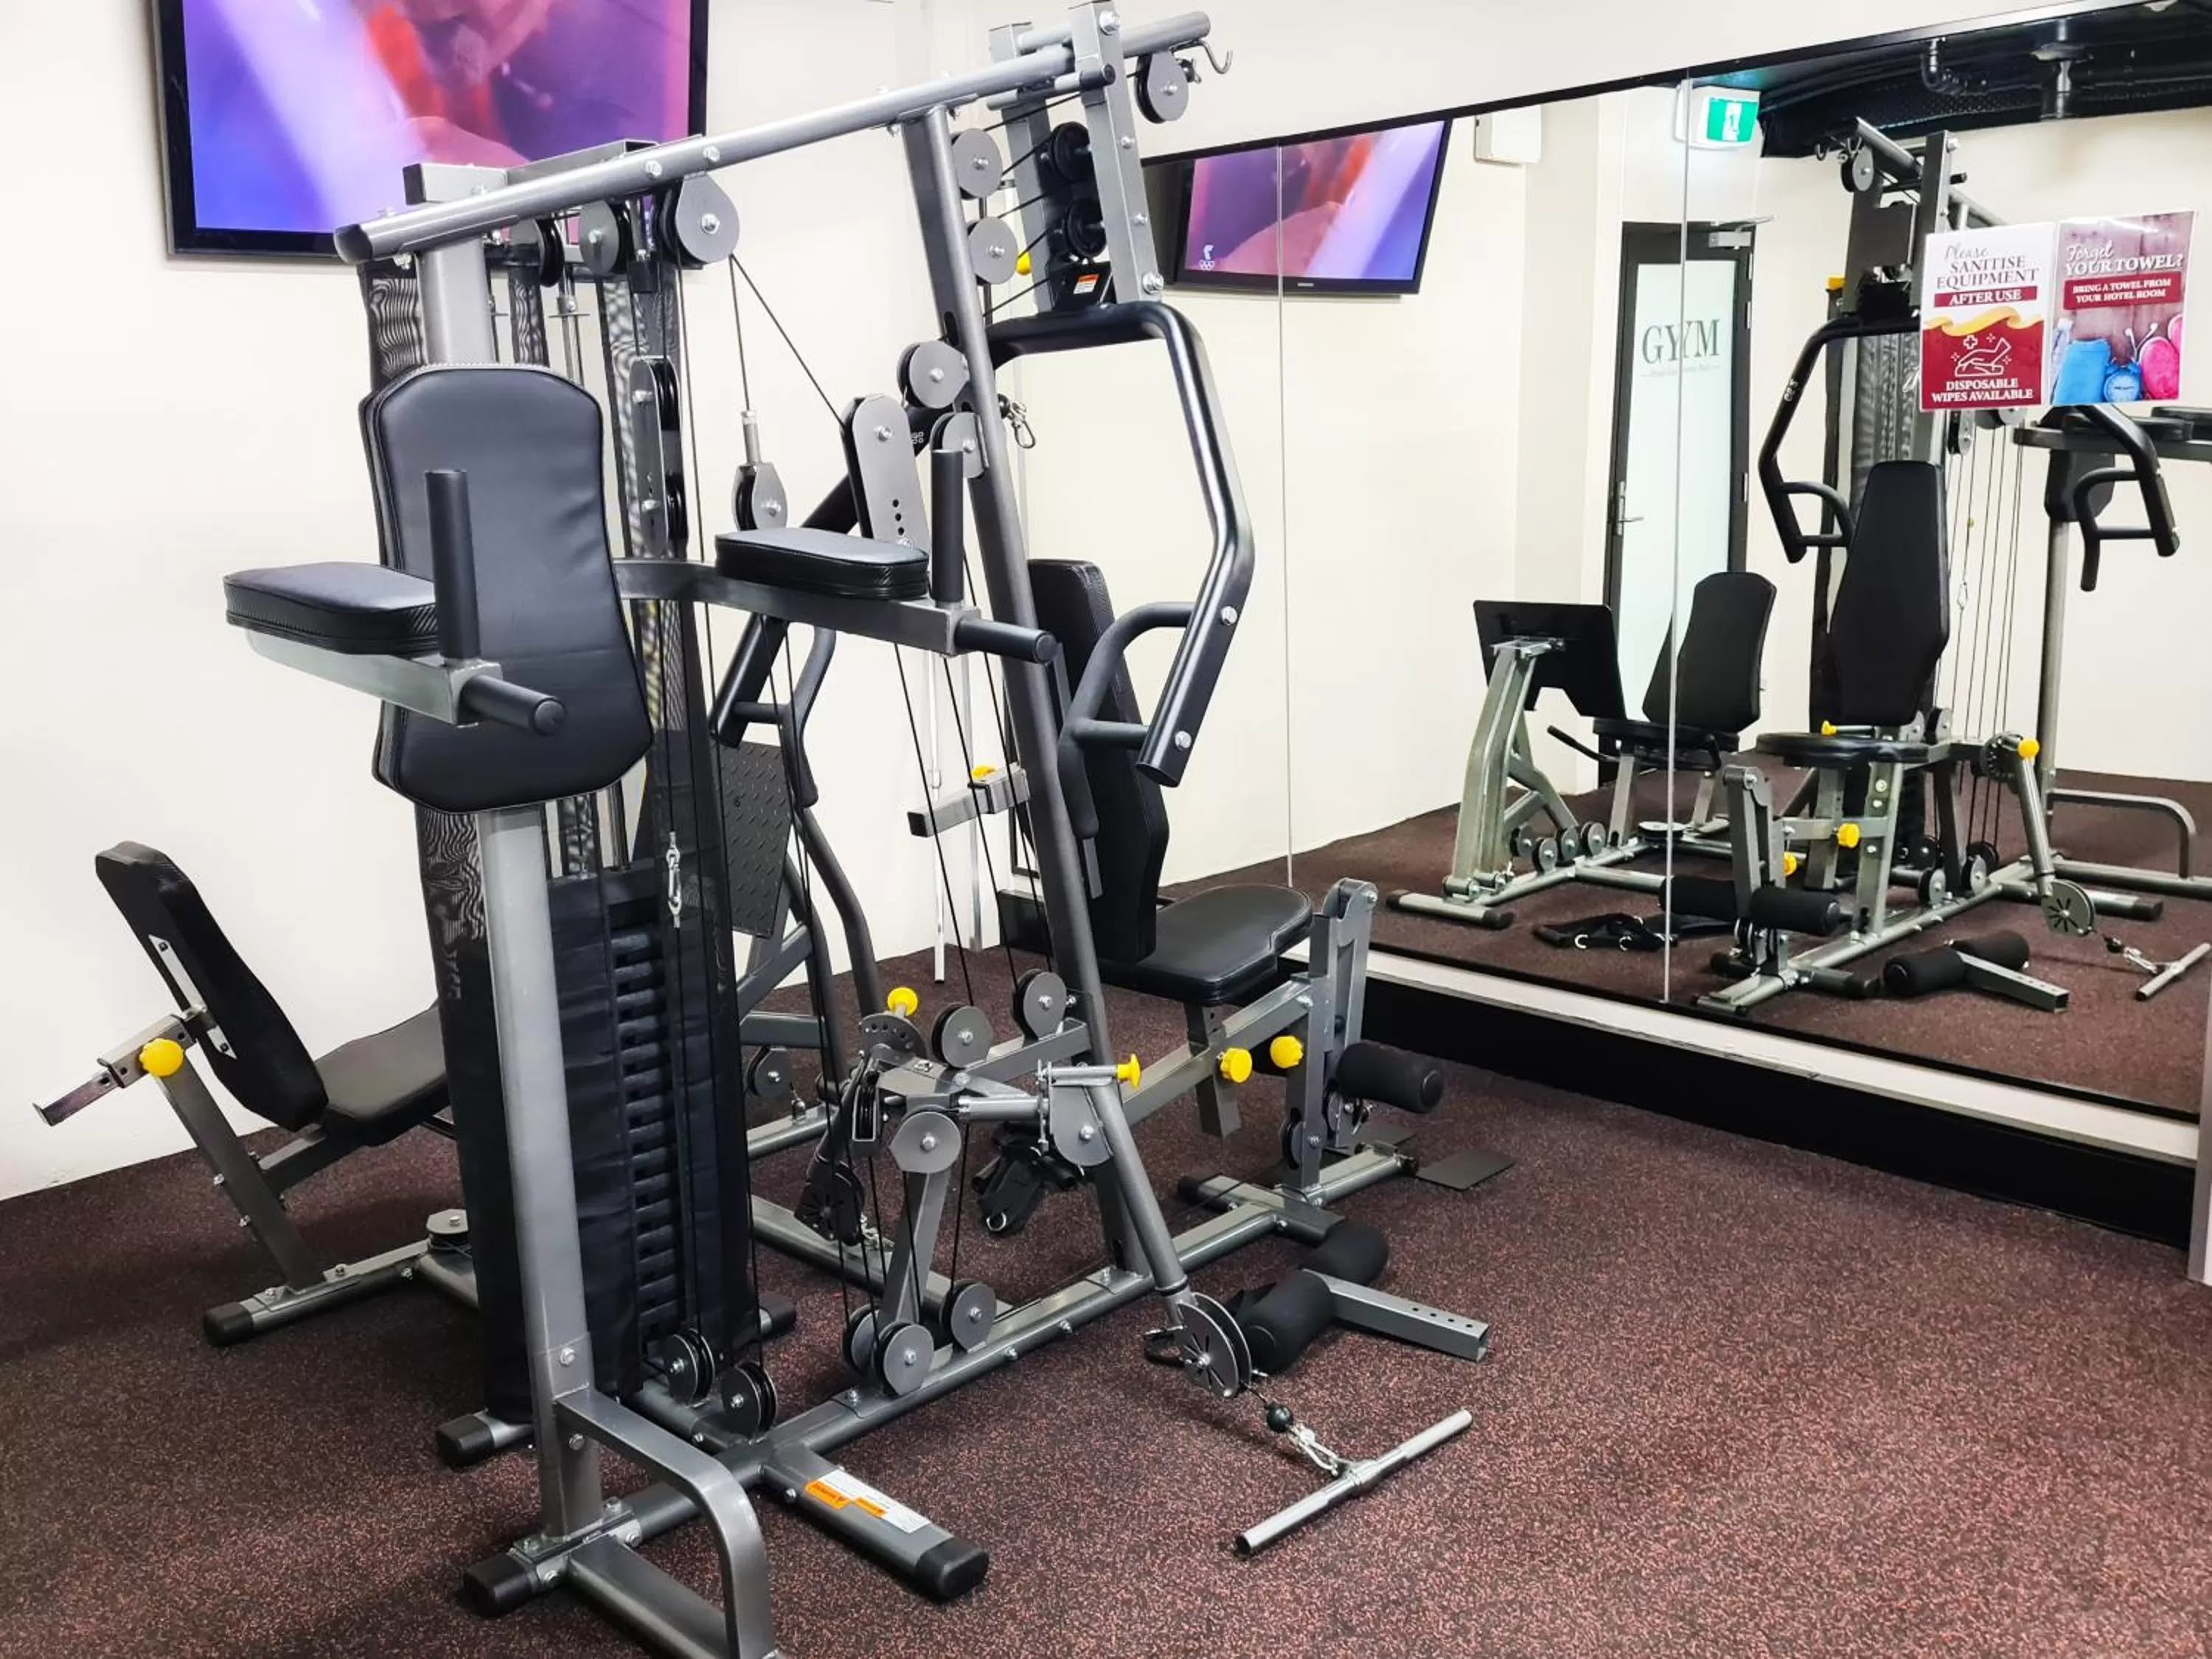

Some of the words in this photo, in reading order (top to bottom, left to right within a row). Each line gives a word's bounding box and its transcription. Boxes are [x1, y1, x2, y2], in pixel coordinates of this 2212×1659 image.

[1950, 254, 2025, 274] SANITISE
[2065, 258, 2112, 276] YOUR
[2114, 254, 2183, 273] TOWEL?
[1936, 268, 2039, 290] EQUIPMENT
[2073, 283, 2101, 293] BRING
[2110, 280, 2142, 291] TOWEL
[2144, 278, 2171, 288] FROM
[1949, 292, 1993, 306] AFTER
[1996, 288, 2022, 301] USE
[2076, 294, 2102, 303] YOUR
[2104, 292, 2135, 302] HOTEL
[2137, 289, 2166, 299] ROOM
[1642, 319, 1720, 364] GYM
[1946, 378, 2019, 392] DISPOSABLE
[1931, 392, 1968, 403] WIPES
[1969, 389, 2034, 401] AVAILABLE
